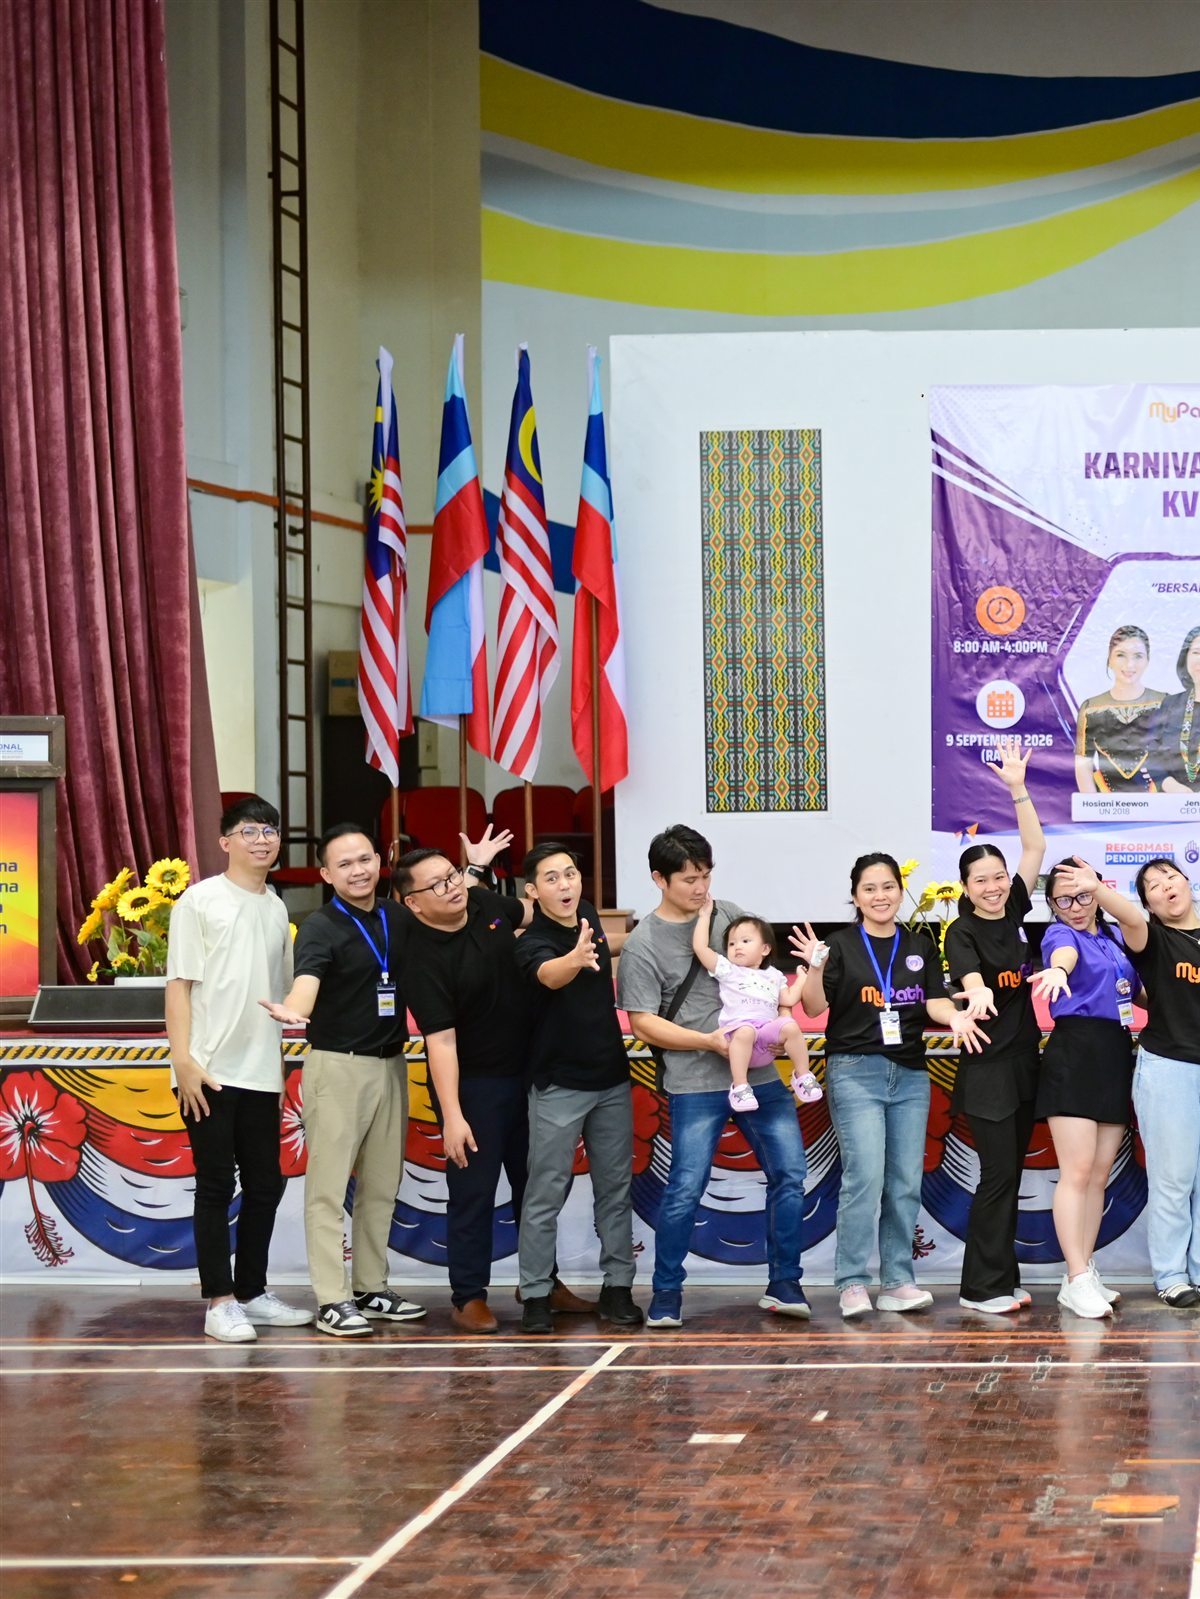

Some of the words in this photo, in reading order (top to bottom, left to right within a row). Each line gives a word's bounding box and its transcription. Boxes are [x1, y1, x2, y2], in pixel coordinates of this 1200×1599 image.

[1162, 490, 1199, 517] KV
[953, 641, 979, 653] 8:00
[982, 641, 1048, 653] AM-4:00PM
[946, 734, 954, 746] 9
[956, 734, 1022, 746] SEPTEMBER
[1024, 734, 1053, 746] 2026
